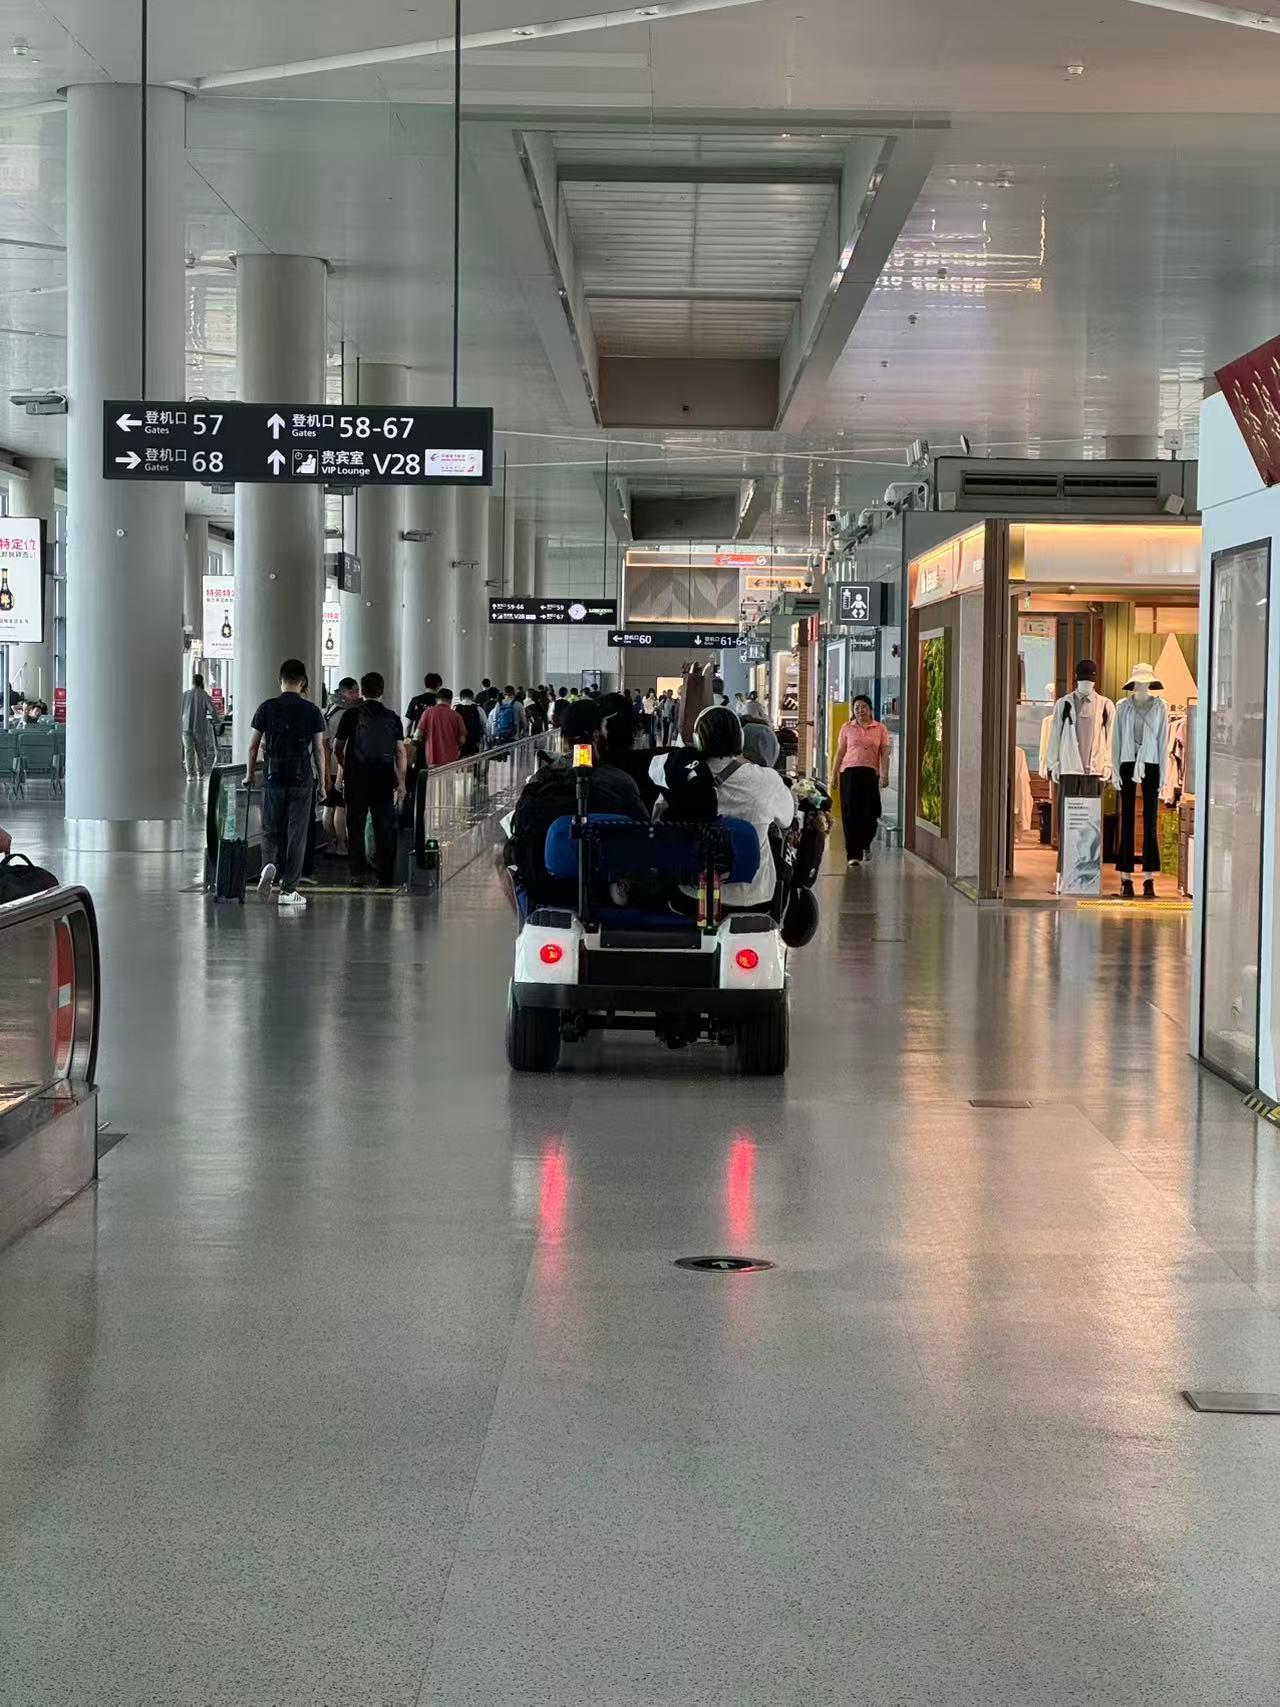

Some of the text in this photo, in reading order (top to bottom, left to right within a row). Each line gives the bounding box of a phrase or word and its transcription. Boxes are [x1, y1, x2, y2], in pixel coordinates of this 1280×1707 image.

[145, 411, 223, 435] 登机口 57
[292, 413, 414, 439] 登机口 58-67
[144, 425, 169, 434] Gates
[291, 428, 316, 437] Gates
[145, 447, 223, 473] 登机口 68
[321, 450, 420, 475] 贵宾室 V28
[144, 463, 169, 471] Gates
[321, 466, 371, 477] VIP Lounge
[639, 635, 652, 645] 60
[720, 636, 748, 646] 61-64
